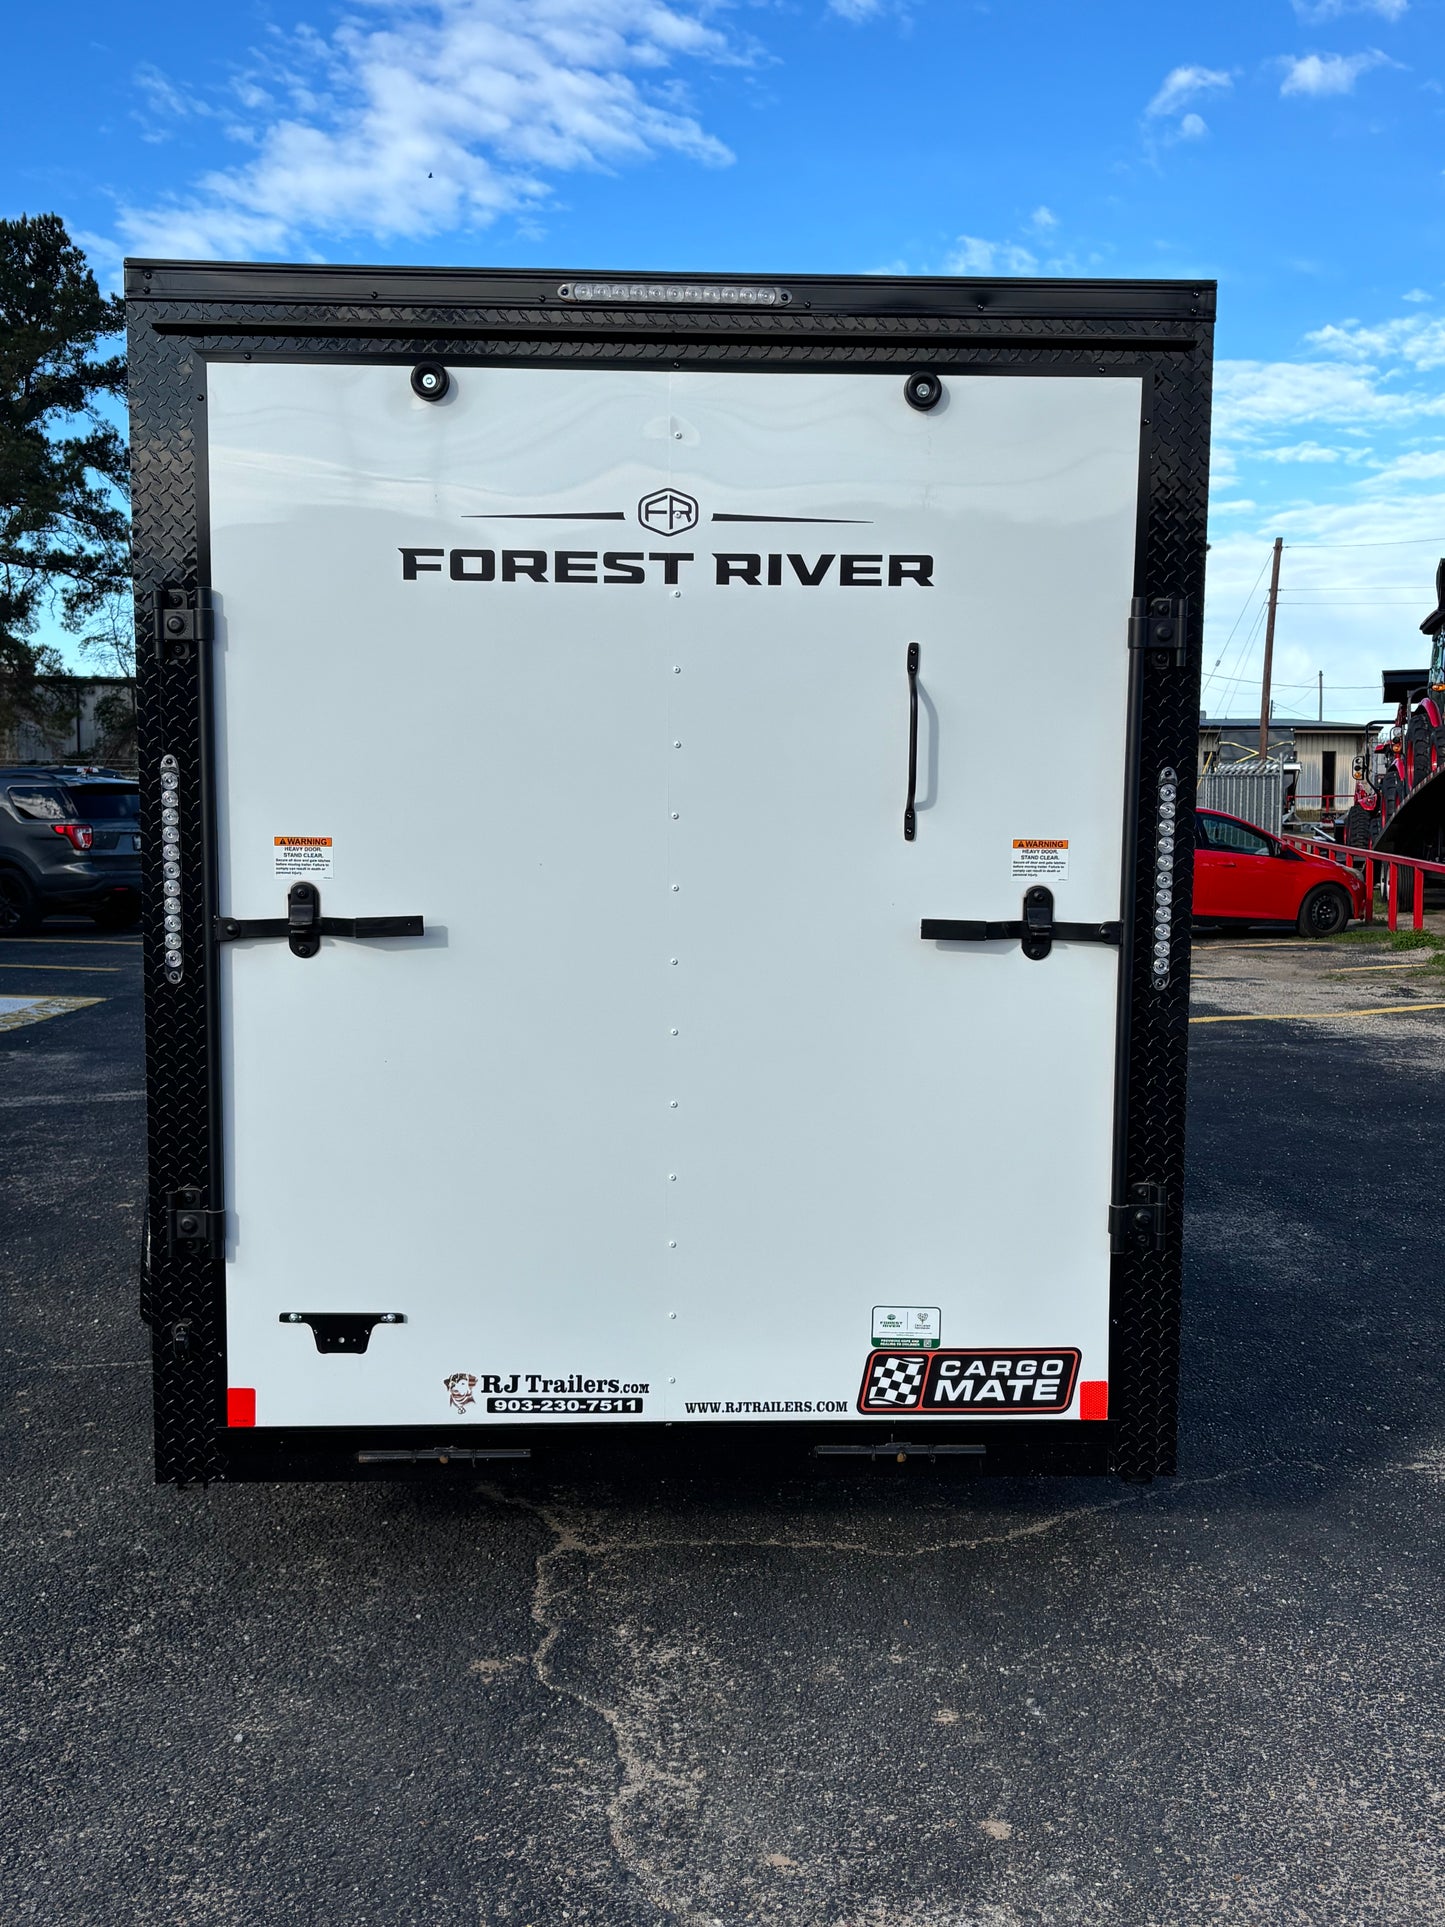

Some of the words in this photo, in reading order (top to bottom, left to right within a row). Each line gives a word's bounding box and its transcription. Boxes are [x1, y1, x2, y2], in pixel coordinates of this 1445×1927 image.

[397, 547, 694, 585] FOREST
[712, 552, 935, 587] RIVER
[939, 1360, 1064, 1377] CARGO
[481, 1375, 521, 1394] RJ
[933, 1378, 1059, 1401] MATE
[494, 1400, 637, 1411] 903-230-7511
[685, 1400, 848, 1414] WWW.RJTRAILERS.COM
